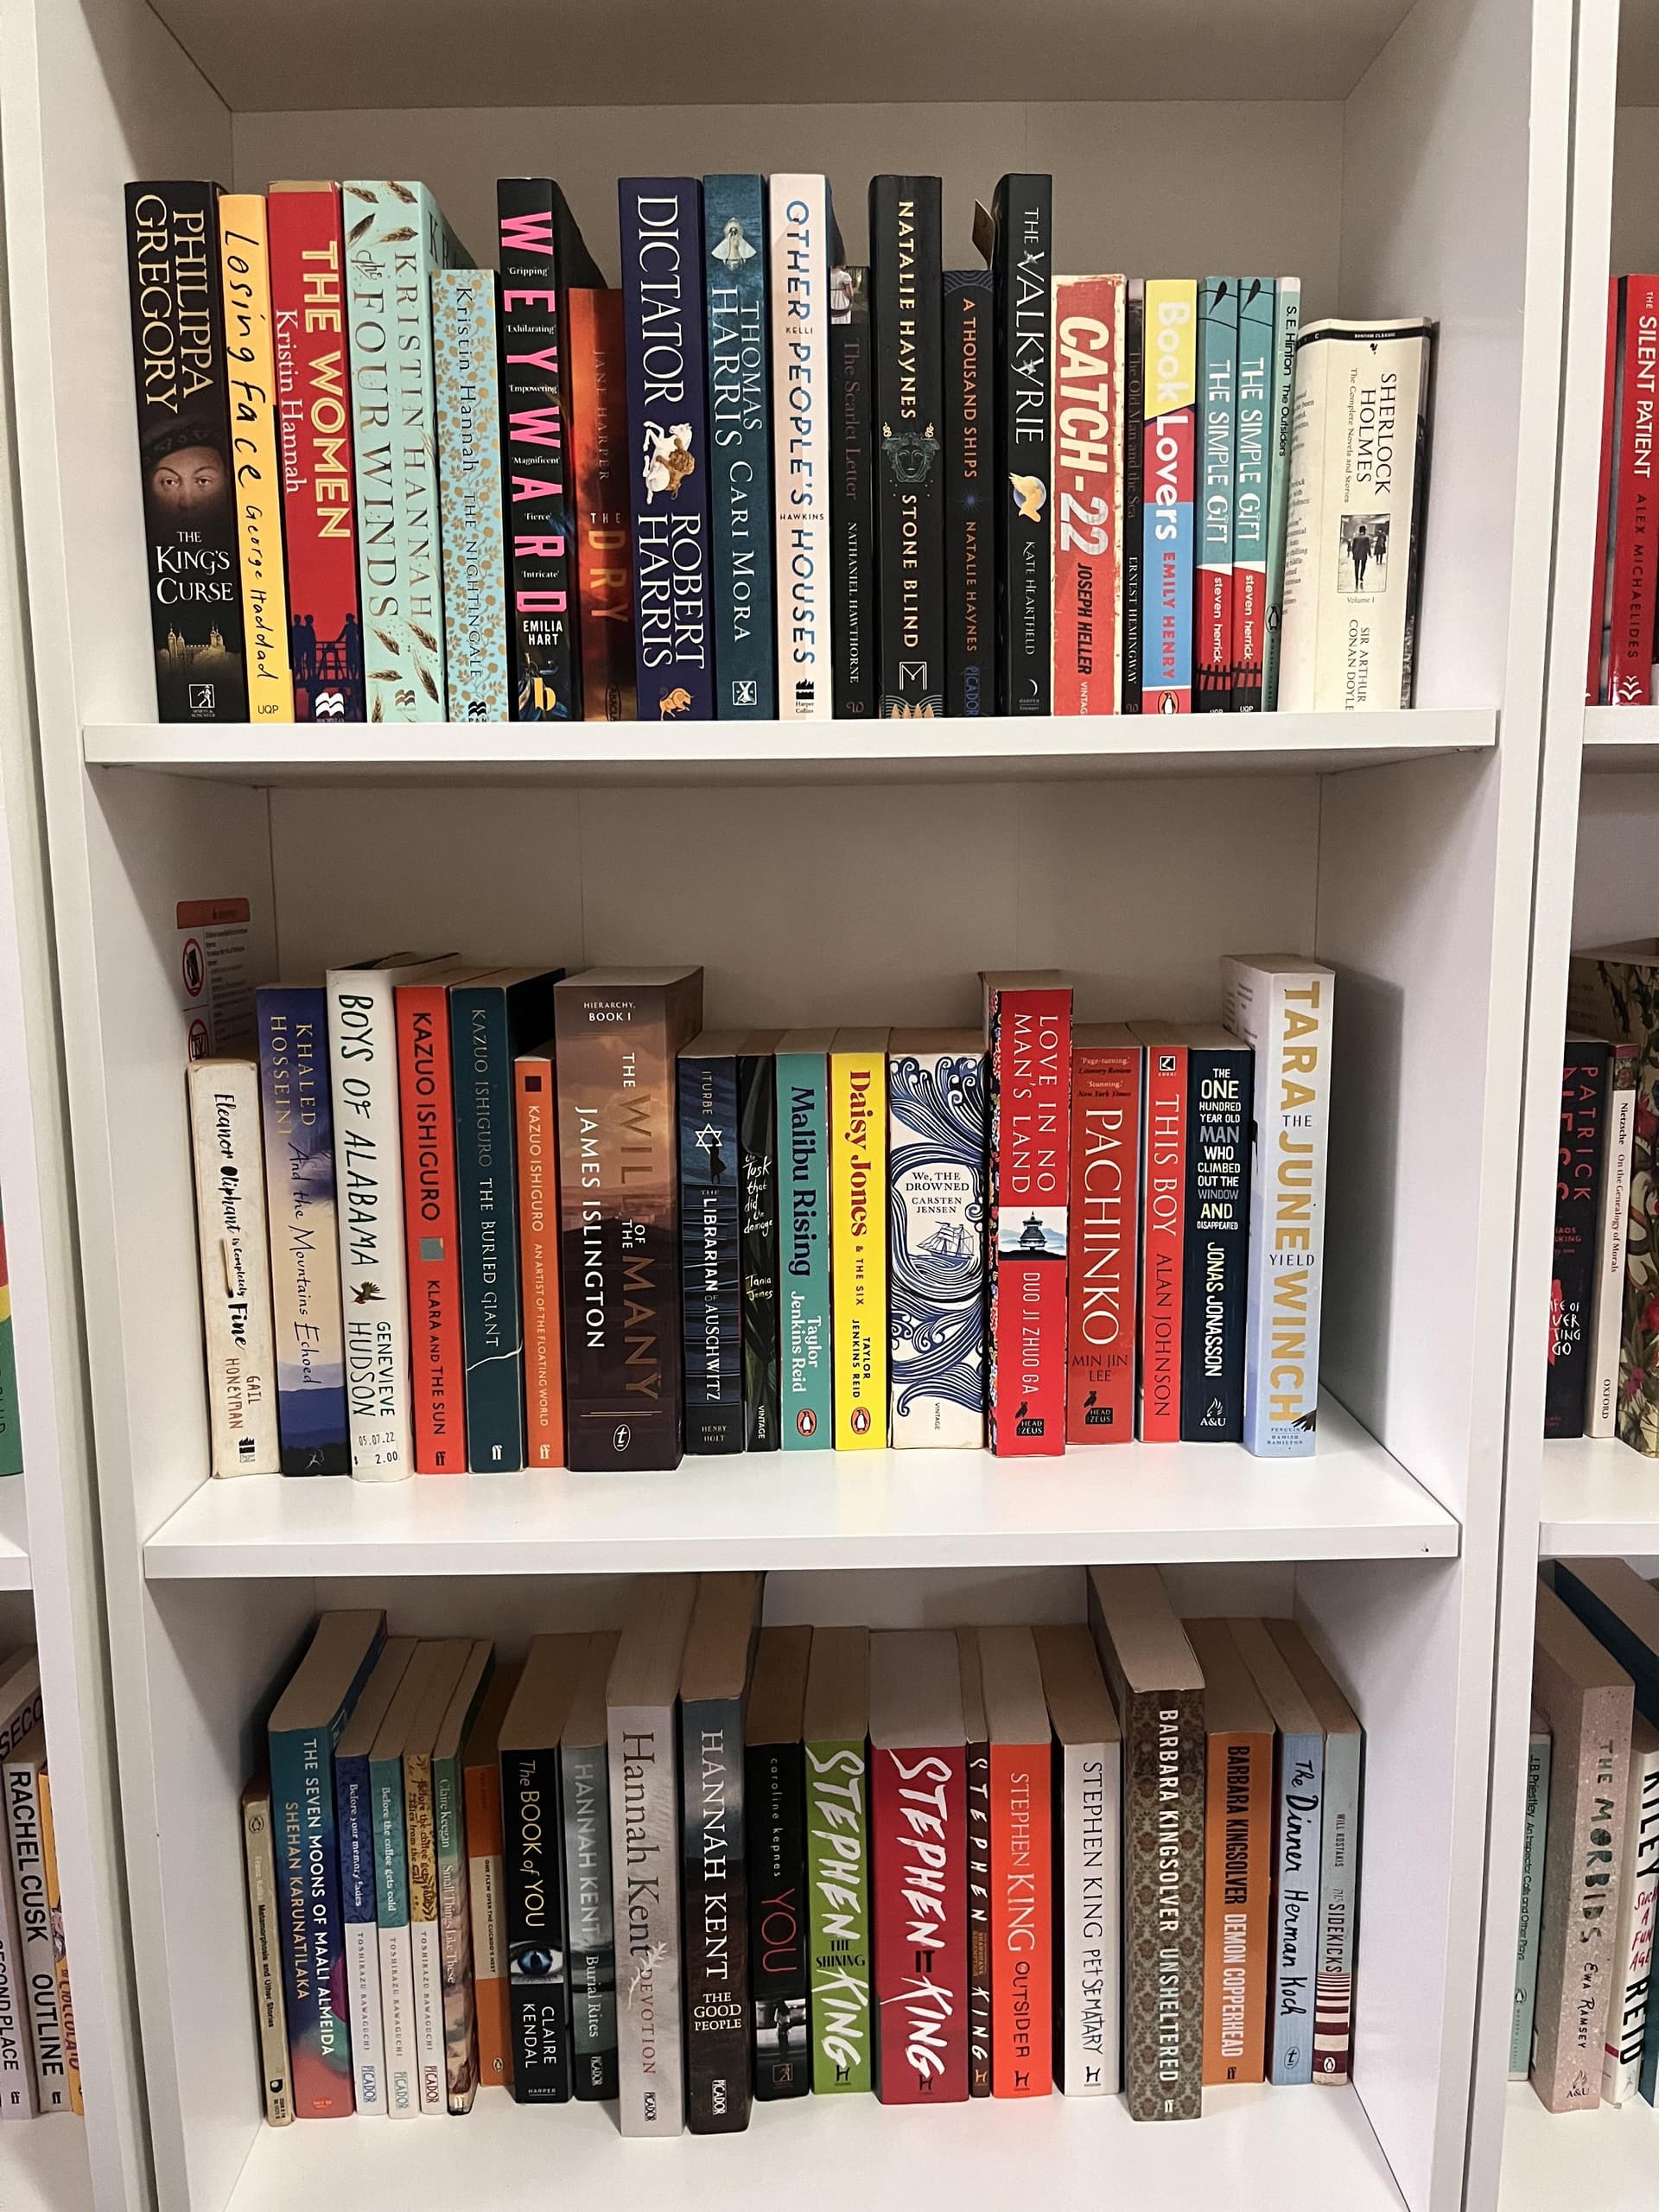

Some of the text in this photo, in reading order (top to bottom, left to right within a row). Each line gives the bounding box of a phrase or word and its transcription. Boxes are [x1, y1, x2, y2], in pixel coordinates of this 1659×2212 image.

[135, 194, 177, 413] GREGORY
[173, 209, 214, 399] PHILIPPA
[637, 195, 684, 406] DICTATOR
[276, 309, 305, 494] Kristin Hannah
[300, 241, 351, 538] THE WOMEN
[456, 288, 480, 472] Kristin Hannah
[711, 287, 743, 448] HARRIS
[740, 301, 762, 431] THOMAS
[1350, 368, 1358, 384] The
[1637, 315, 1657, 393] SILENT
[1058, 316, 1109, 556] CATCH-22
[1155, 302, 1190, 540] Book Lovers
[1347, 386, 1357, 426] Complete
[1357, 390, 1376, 483] HOLMES
[1375, 373, 1397, 496] SHERLOCK
[1633, 400, 1654, 479] PATIENT
[176, 531, 202, 543] THE
[902, 494, 918, 648] STONE BLIND
[1627, 493, 1648, 659] ALEX MICHAELIDES
[156, 578, 233, 606] CURSE
[464, 495, 482, 677] THE NIGHTINGALE
[523, 620, 563, 632] EMILIA
[638, 514, 673, 669] HARRIS
[670, 513, 705, 670] ROBERT
[847, 523, 859, 683] NATHANIEL HAWTHORNE
[1023, 541, 1036, 655] KATE HEARTFIELD
[1077, 563, 1093, 675] JOSEPH HELLER
[1128, 556, 1138, 683] ERNEST HEMINGWAY
[1161, 552, 1175, 679] EMILY HENRY
[528, 634, 559, 645] HART
[1213, 623, 1222, 663] herrick
[1244, 621, 1253, 659] herrick
[1357, 628, 1370, 702] SIR ARTHUR
[258, 705, 278, 715] UQP
[270, 1015, 292, 1135] HOSSEINI
[296, 1023, 317, 1126] KHALED
[701, 1071, 712, 1115] ITURBE
[1201, 1080, 1239, 1099] ONE
[1212, 1069, 1230, 1078] THE
[1281, 981, 1320, 1110] TARA
[338, 995, 378, 1265] BOYS OF ALABAMA
[1012, 1014, 1035, 1193] MAN'S LAND
[1037, 1015, 1058, 1192] LOVE IN NO
[1199, 1102, 1241, 1111] HUNDRED
[1199, 1126, 1239, 1143] MAN
[1200, 1114, 1240, 1123] YEAR OLD
[906, 1183, 969, 1192] DROWNED
[1198, 1163, 1240, 1173] CLIMBED
[1198, 1176, 1239, 1186] OUT THE
[1198, 1190, 1238, 1199] WINDOW
[1205, 1146, 1234, 1160] WHO
[412, 1013, 446, 1434] KAZUO ISHIGURO KLARA AND THE SUN
[575, 1107, 605, 1348] JAMES ISLINGTON
[1082, 1109, 1123, 1344] PACHINKO
[1197, 1221, 1238, 1230] DISAPPEARED
[1200, 1204, 1233, 1219] AND
[1269, 1254, 1314, 1266] YIELD
[622, 1255, 658, 1400] MANY
[791, 1292, 806, 1392] Jenkins Reid
[807, 1315, 823, 1368] Taylor
[1154, 1254, 1172, 1416] ALAN JOHNSON
[1205, 1242, 1224, 1376] JONAS JONASSON
[225, 1357, 243, 1429] HONEYMAN
[246, 1376, 261, 1405] GAIL
[348, 1322, 376, 1417] HUDSON
[377, 1321, 395, 1417] GENEVIEVE
[862, 1338, 871, 1379] TAYLOR
[1602, 1379, 1611, 1419] OXFORD
[359, 1432, 396, 1446] 05.07.22
[285, 1802, 310, 1999] SHEHAN KARUNATILAKA
[701, 1729, 728, 1980] HANNAH KENT
[1007, 1773, 1034, 1951] STEPHEN KING
[1159, 1710, 1179, 2081] BARBARA KINGSOLVER UNSHELTERED
[1221, 1746, 1250, 2057] BARBARA KINGSOLVER DEMON COPPERHEAD
[1325, 1814, 1344, 1973] WILL KOSTAKIS SIDEKICKS
[10, 1772, 64, 2076] RACHEL CUSK OUTLINE
[915, 1950, 935, 1973] IT
[357, 1933, 371, 2050] TOSHIKAZU KAWAGUCHI
[522, 2004, 537, 2069] KENDAL
[541, 2006, 556, 2064] CLAIRE
[586, 1955, 601, 2037] Burial Rites
[694, 2005, 741, 2018] GOOD
[695, 2019, 741, 2031] PEOPLE
[703, 1993, 732, 2003] THE
[1014, 1961, 1030, 2057] OUTSIDER
[361, 2066, 377, 2103] PICADOR
